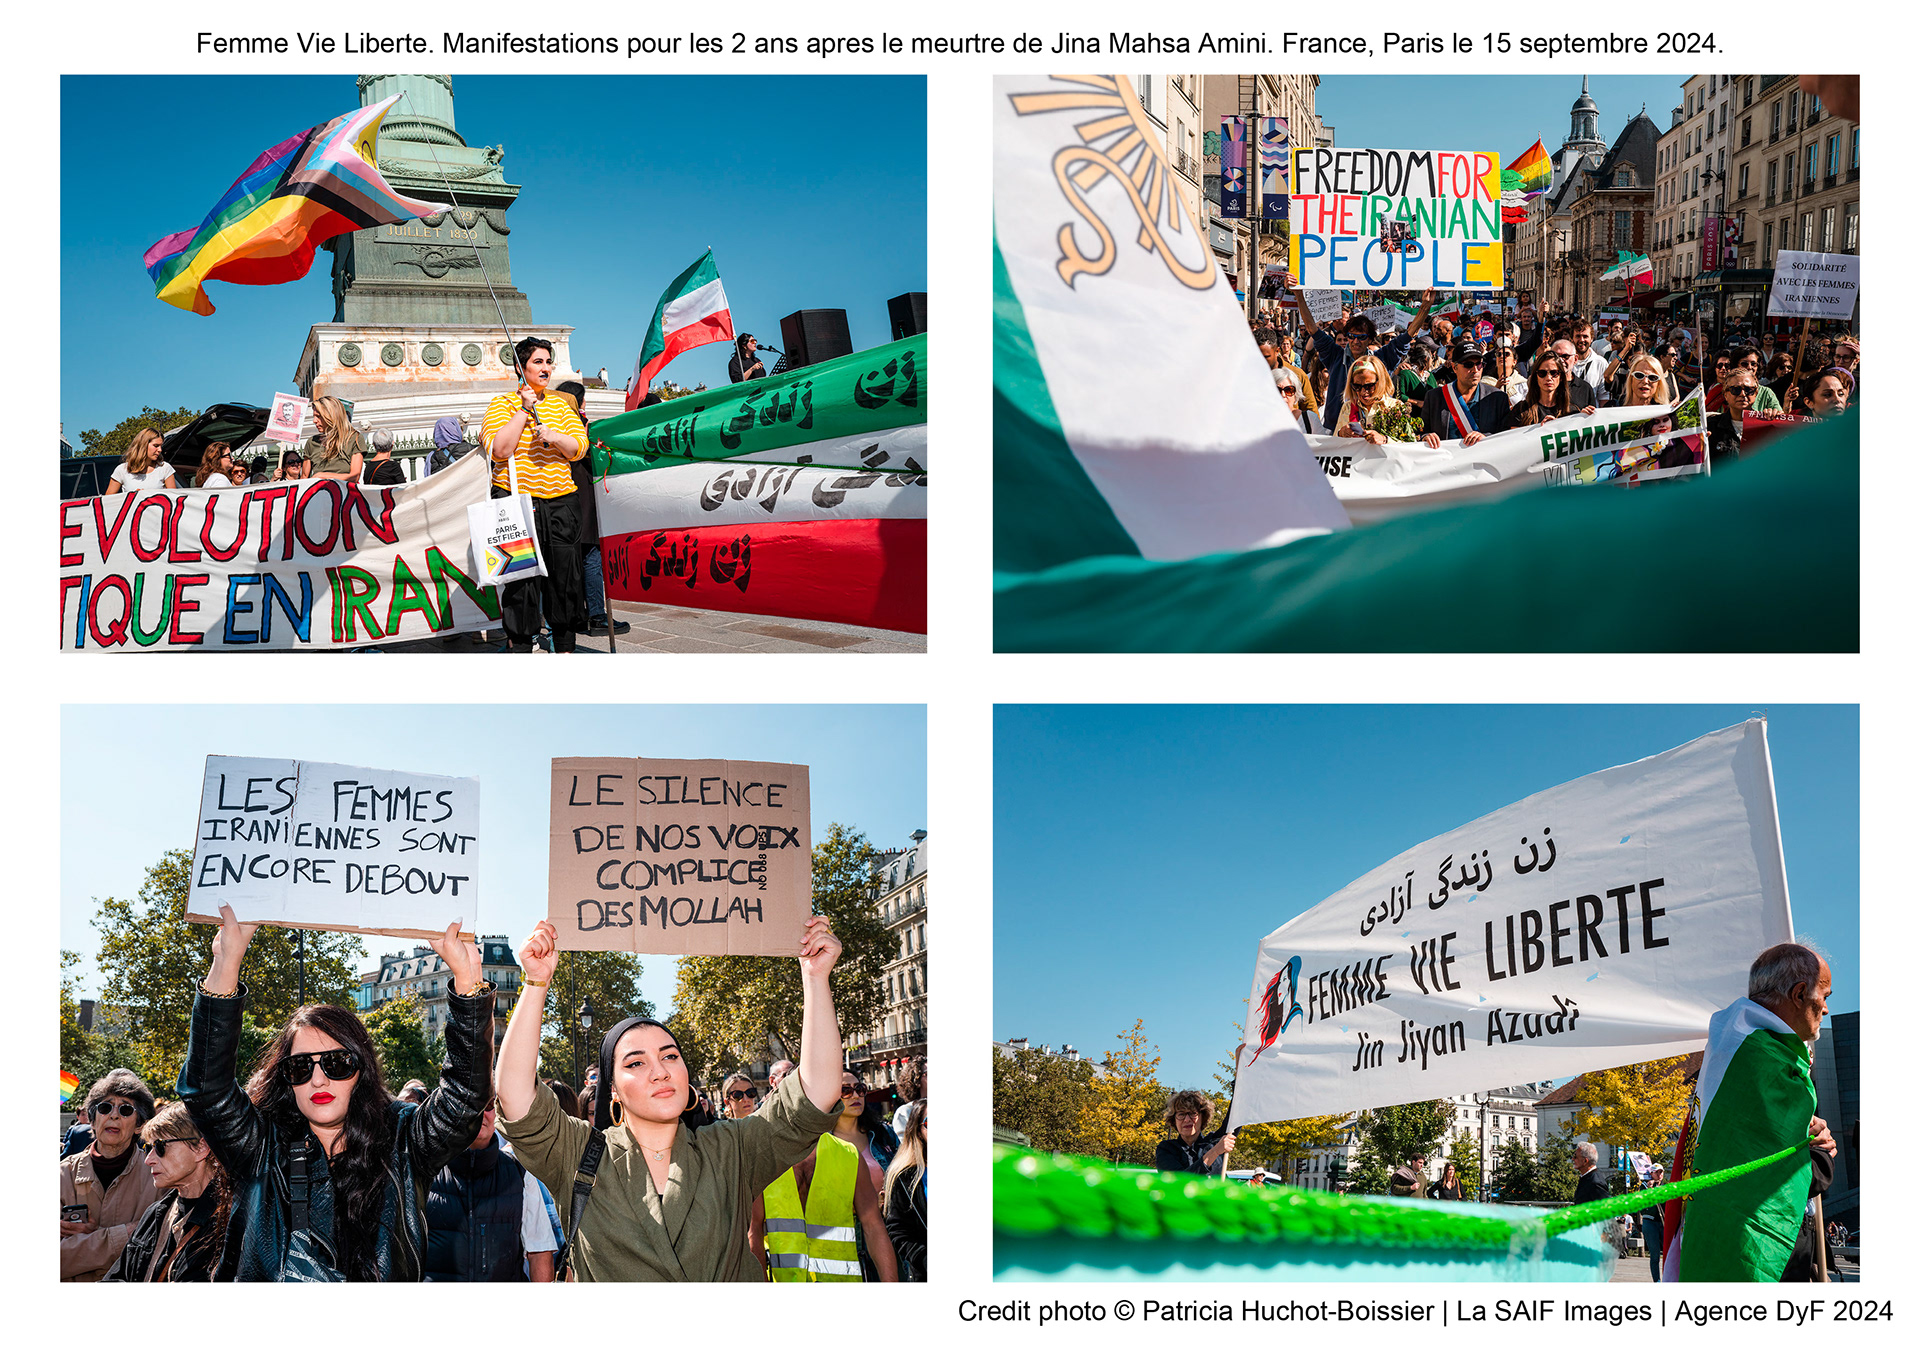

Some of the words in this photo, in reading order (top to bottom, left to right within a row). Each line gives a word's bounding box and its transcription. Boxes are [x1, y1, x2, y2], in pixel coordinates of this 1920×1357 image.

[1294, 148, 1437, 198] FREEDOM
[1436, 153, 1495, 203] FOR
[386, 226, 442, 239] JUILLET
[450, 229, 478, 240] 1830
[1291, 194, 1362, 235] THE
[1299, 233, 1493, 288] PEOPLE
[1705, 244, 1713, 267] PARIS
[1791, 261, 1847, 273] SOLIDARITÉ
[1776, 277, 1801, 287] AVEC
[1801, 279, 1817, 288] LES
[1818, 280, 1856, 290] FEMMES
[1784, 294, 1841, 304] IRANIENNES
[1540, 421, 1634, 463] FEMME
[1543, 458, 1584, 488] VIE
[59, 479, 401, 568] EVOLUTION
[487, 535, 501, 545] EST
[495, 523, 518, 535] PARIS
[223, 571, 313, 645] EN
[325, 545, 504, 644] IRAN
[218, 773, 297, 815] LES
[333, 780, 453, 824] FEMMES
[568, 774, 625, 806] LE
[637, 775, 788, 808] SILENCE
[398, 827, 477, 855] SONT
[573, 824, 625, 855] DE
[636, 823, 702, 853] NOS
[707, 823, 801, 850] VOIX
[1514, 826, 1557, 875] زن
[197, 853, 337, 888] ENCORE
[345, 861, 470, 896] DEBOUT
[596, 858, 764, 891] COMPLICE
[1428, 849, 1493, 911] زندگی
[576, 898, 634, 932] DES
[639, 895, 764, 930] MOLLAH
[1360, 870, 1414, 937] آزادی
[1308, 953, 1394, 1025] FEMME
[1410, 931, 1462, 996] VIE
[1485, 877, 1671, 983] LIBERTE
[1352, 1031, 1383, 1073] Jin
[1397, 1019, 1466, 1071] Jiyan
